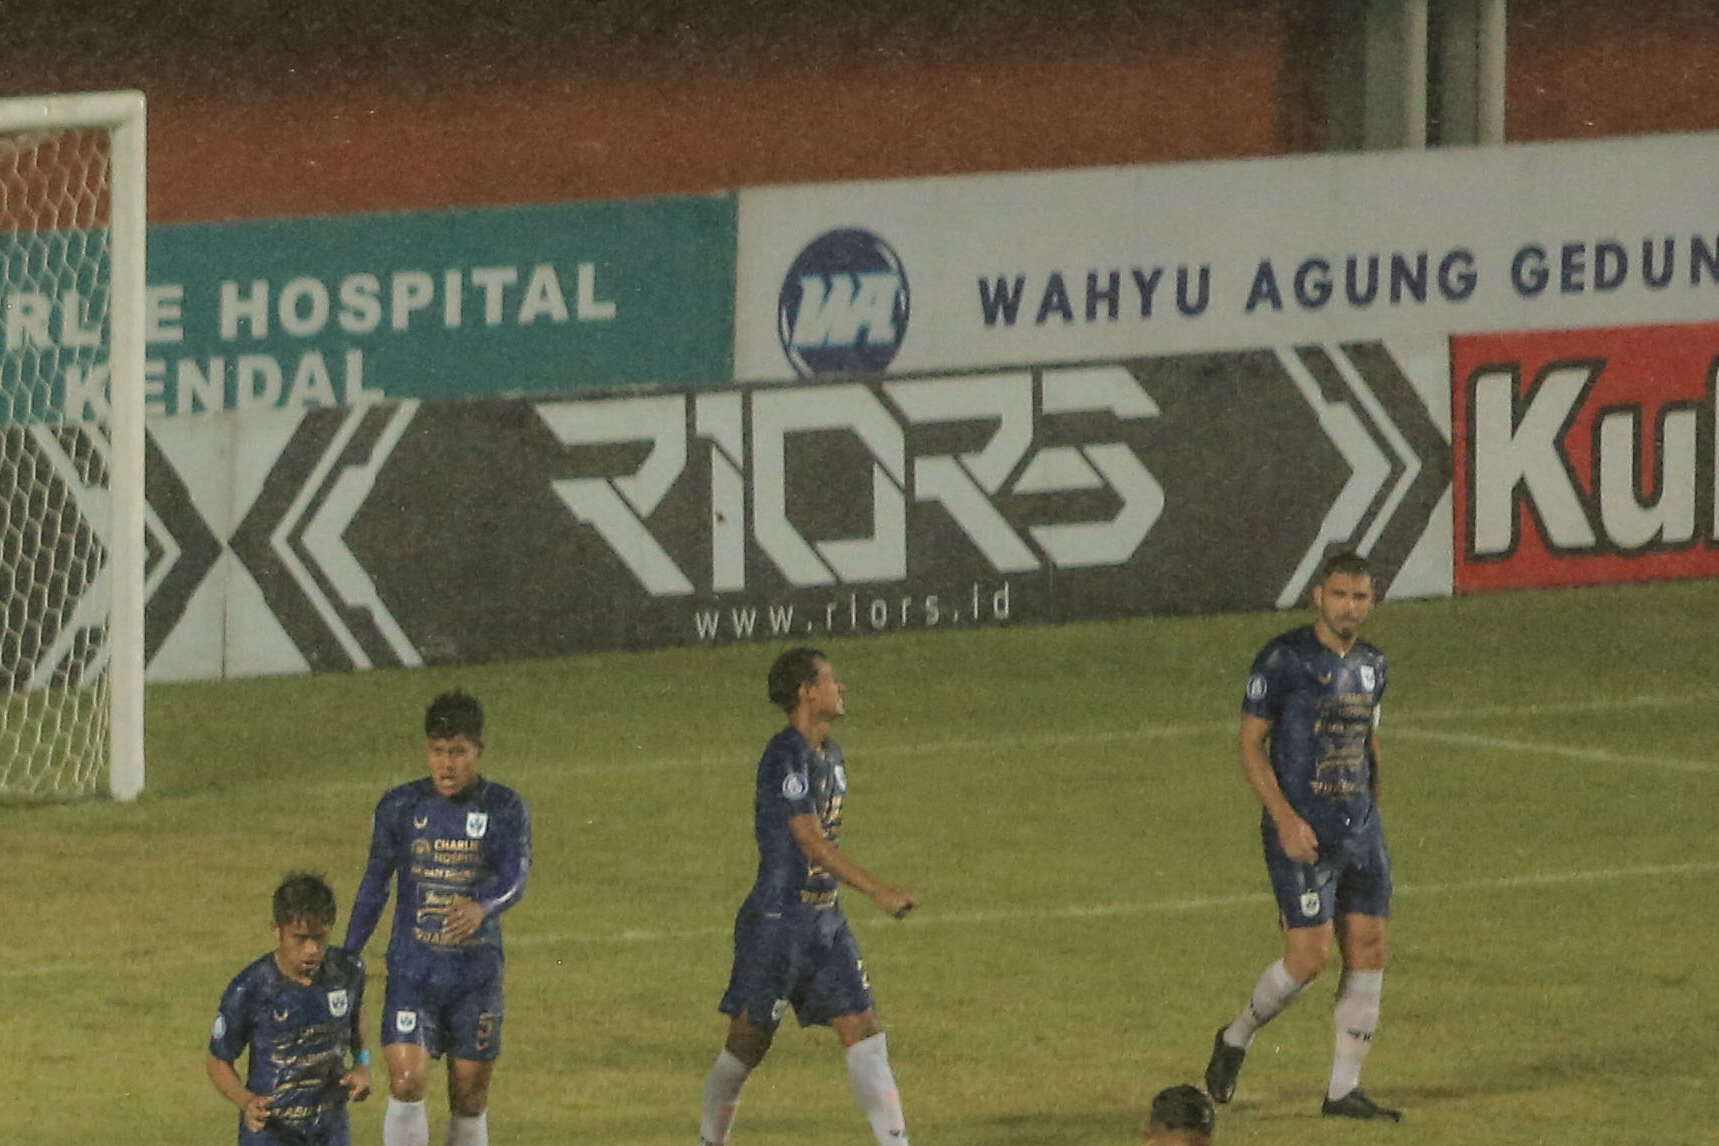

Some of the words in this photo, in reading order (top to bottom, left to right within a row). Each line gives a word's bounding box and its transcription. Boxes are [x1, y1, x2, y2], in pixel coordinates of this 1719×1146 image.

[219, 263, 617, 342] HOSPITAL
[979, 263, 1213, 327] WAHYU
[1247, 247, 1478, 312] AGUNG
[535, 366, 1166, 596] RIORS
[1468, 360, 1719, 560] Ku
